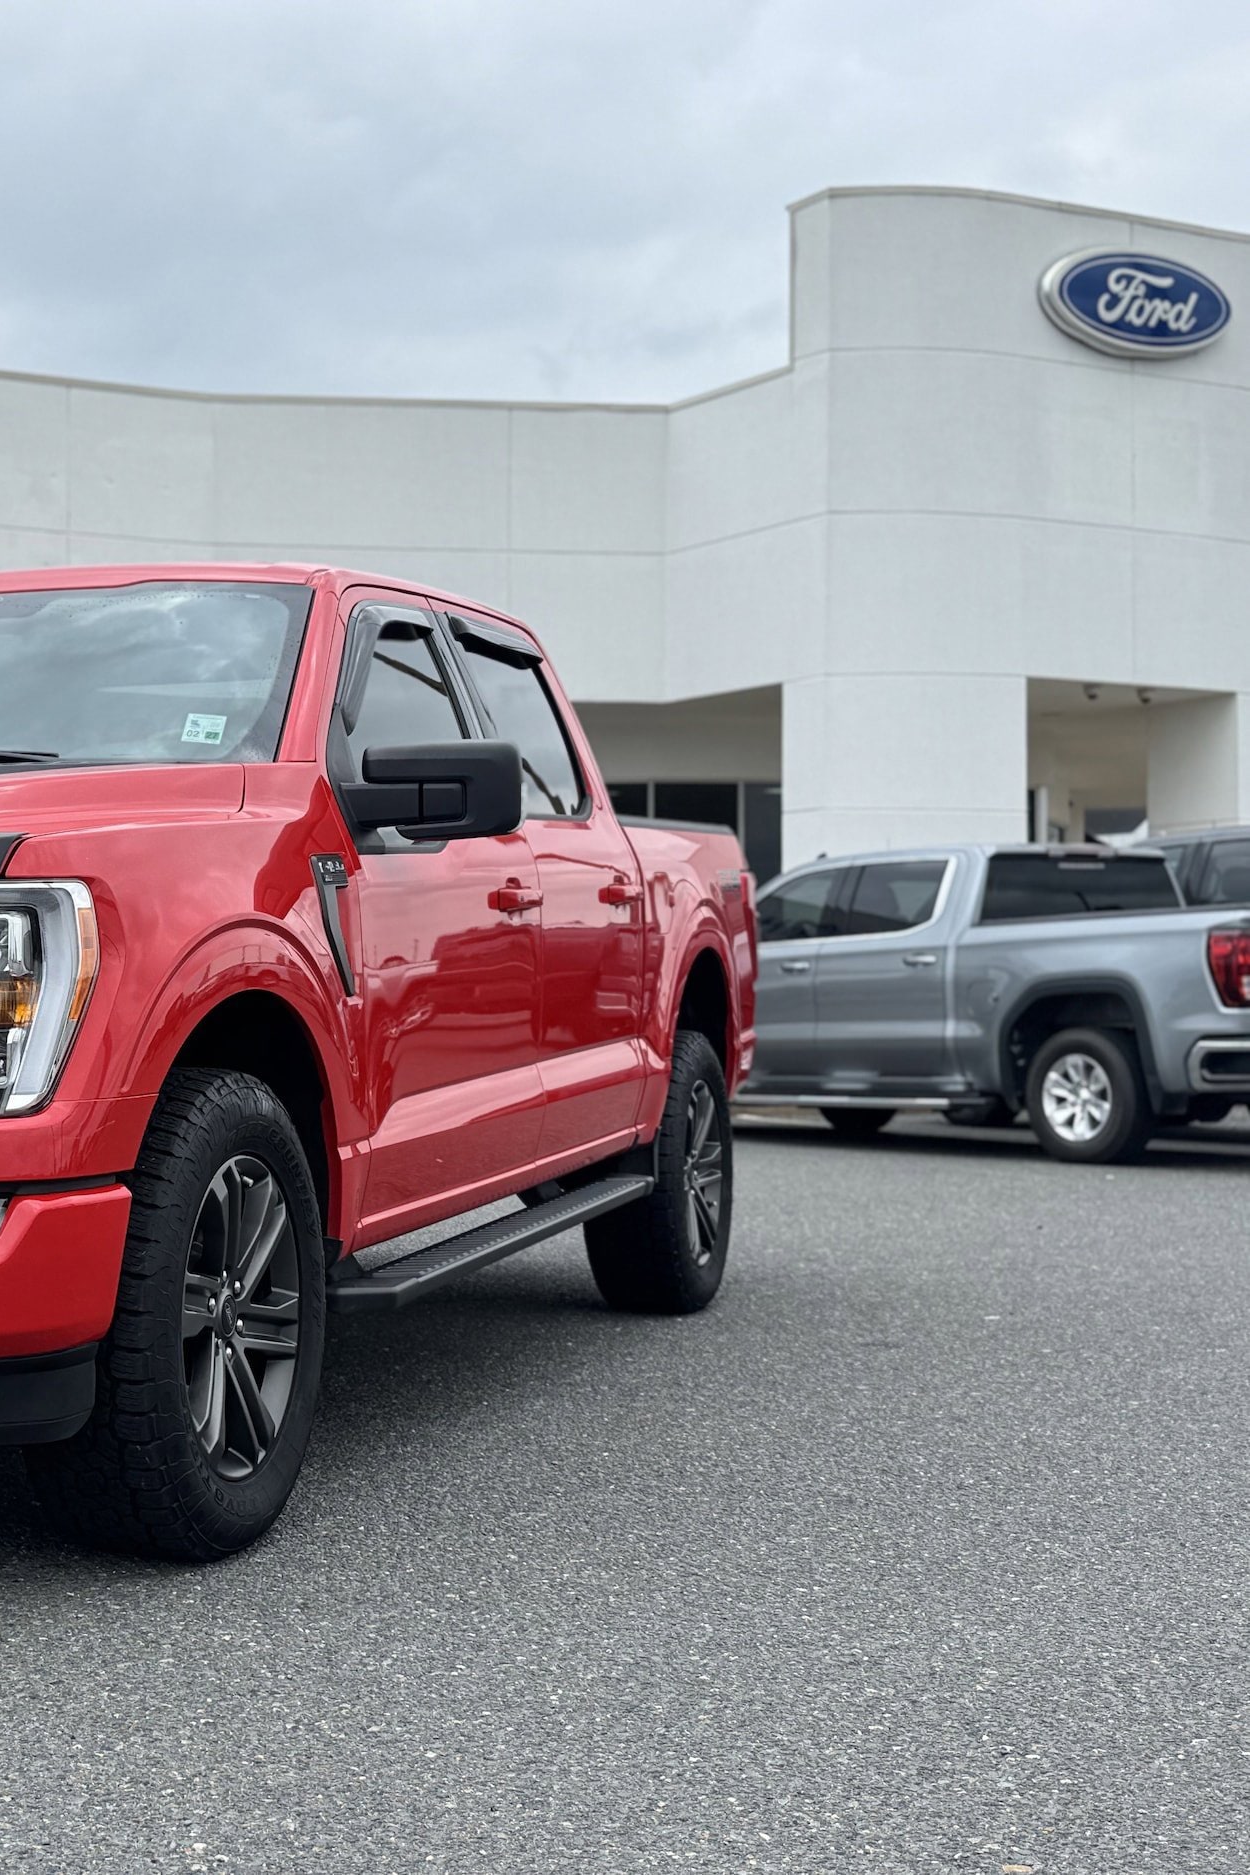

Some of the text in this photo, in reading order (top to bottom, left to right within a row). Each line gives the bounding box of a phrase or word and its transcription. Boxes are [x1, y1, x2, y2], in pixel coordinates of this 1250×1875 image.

[1097, 267, 1199, 333] Ford
[186, 729, 220, 740] 02 27
